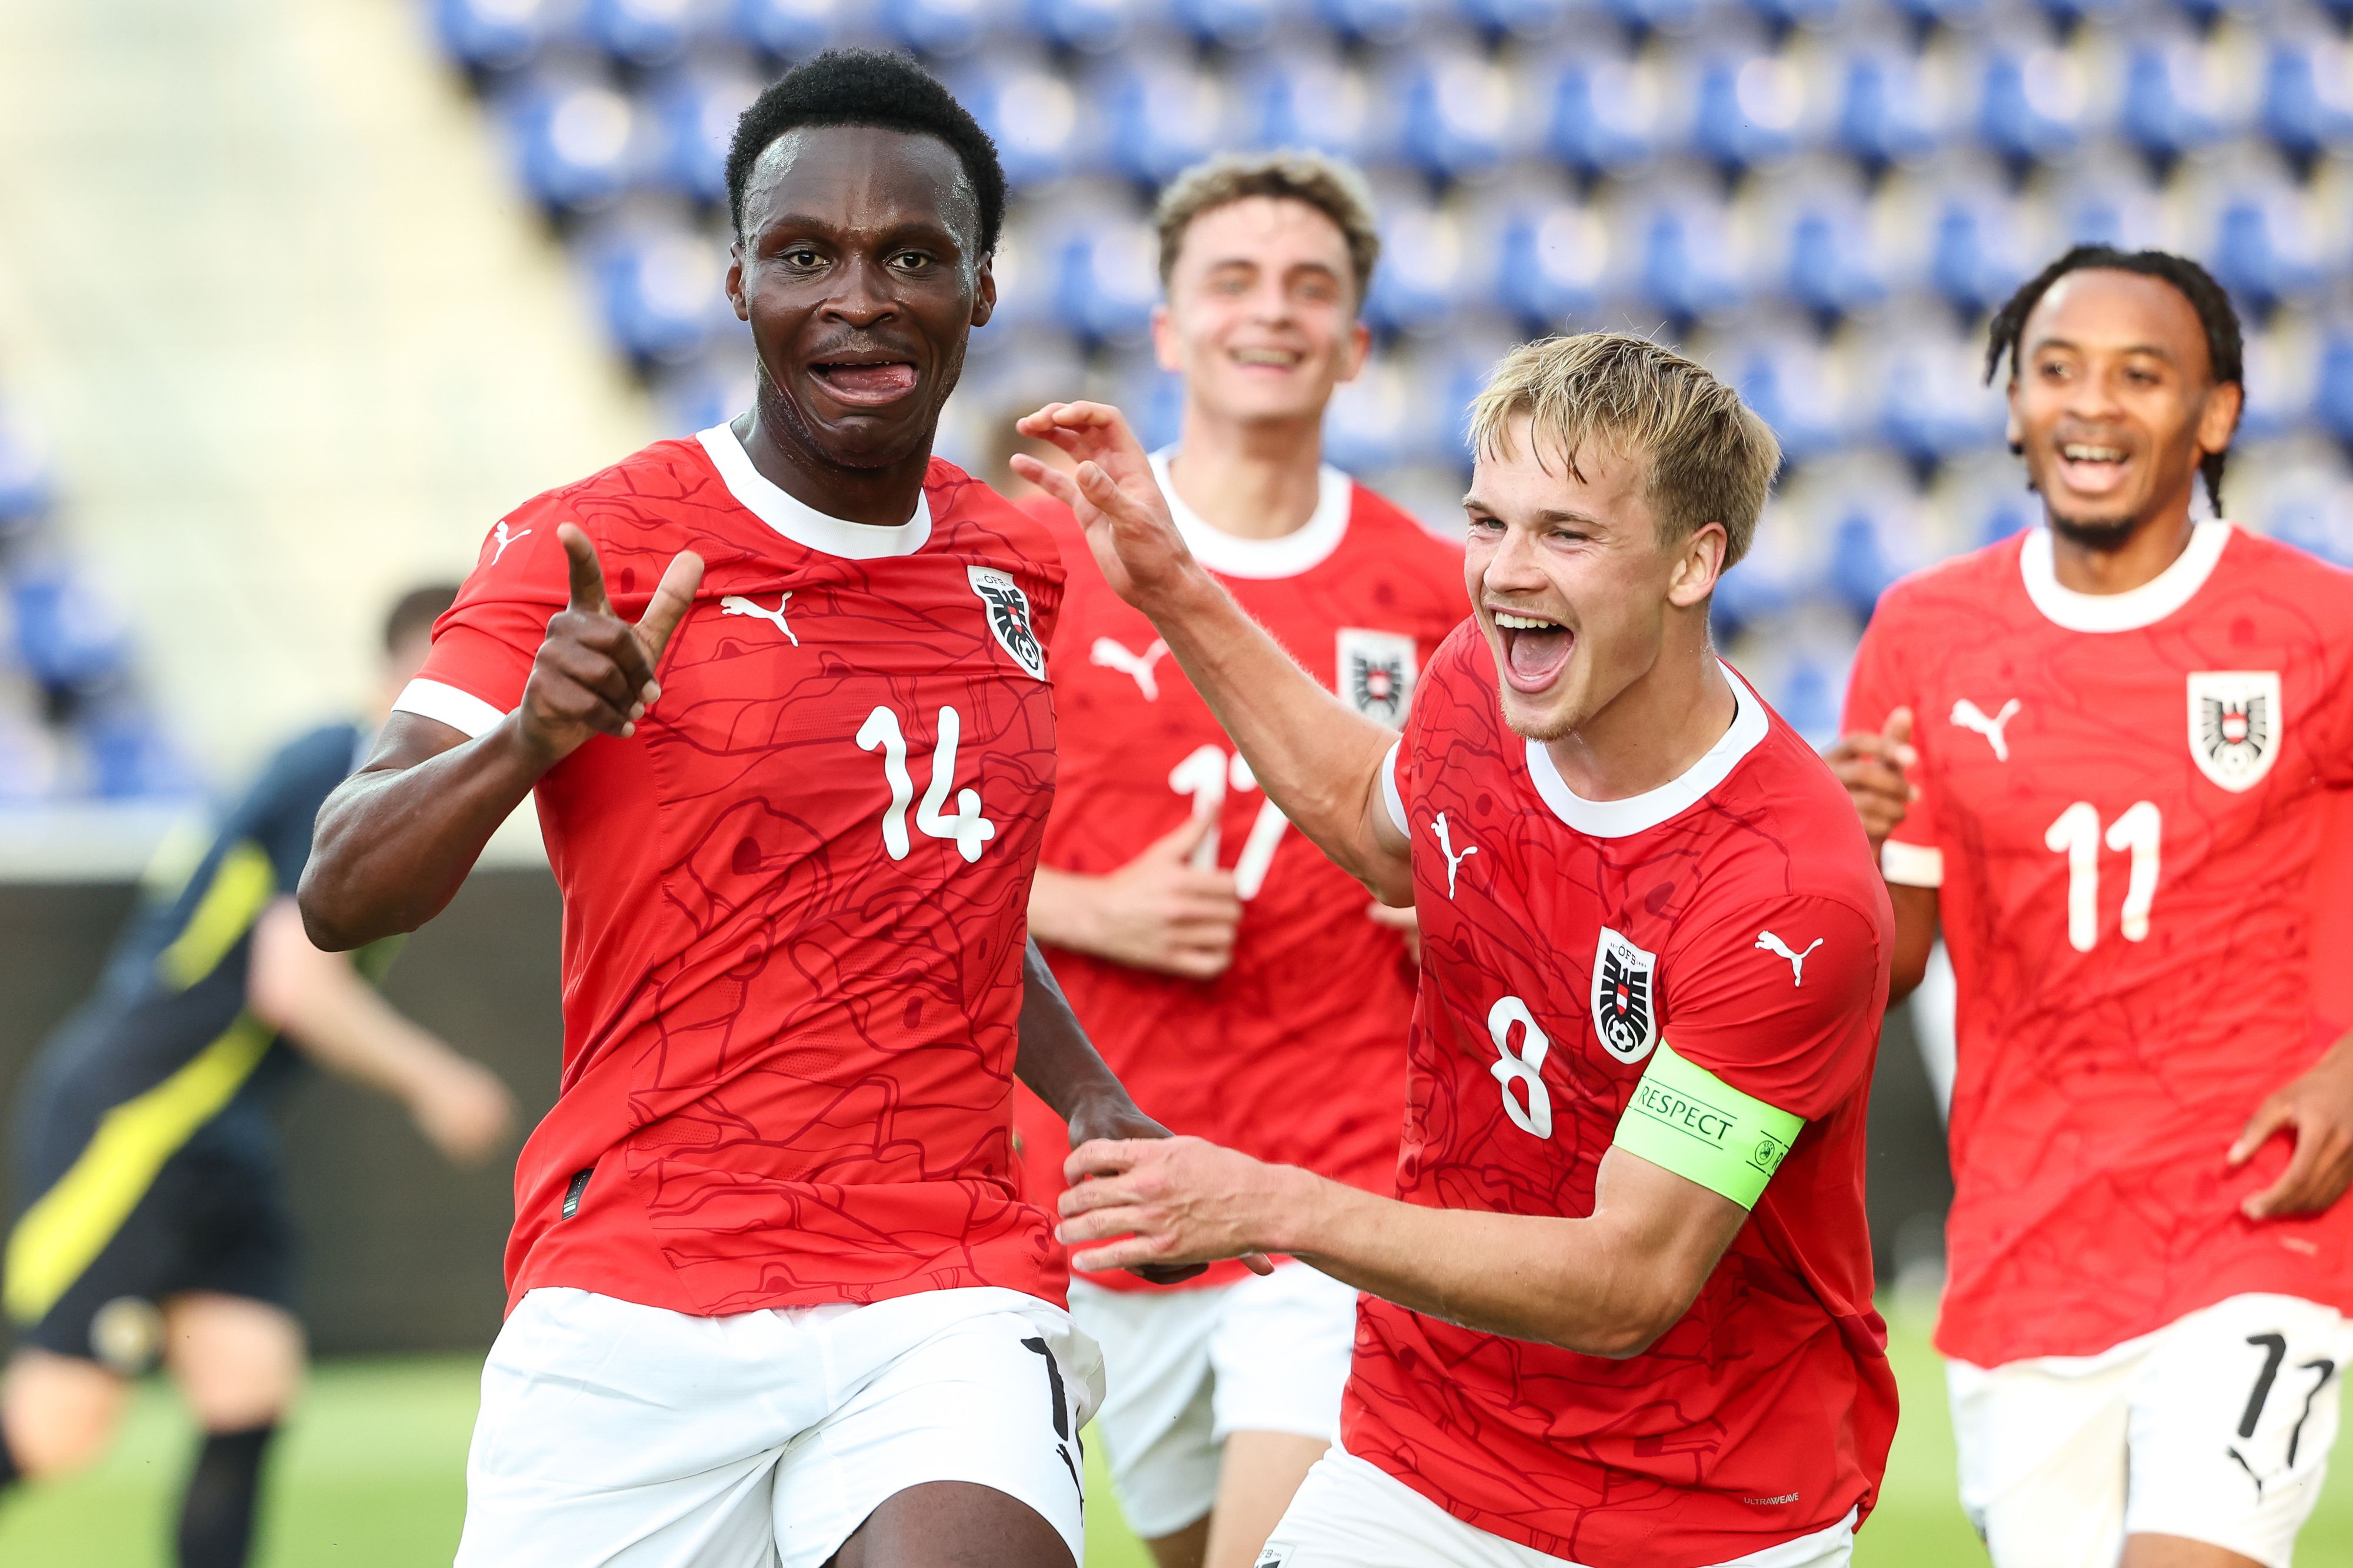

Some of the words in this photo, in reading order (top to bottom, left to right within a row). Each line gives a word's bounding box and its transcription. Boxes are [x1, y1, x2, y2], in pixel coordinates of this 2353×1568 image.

[855, 705, 996, 863] 14
[2044, 800, 2162, 953] 11
[1618, 943, 1636, 966] ÖFB
[1487, 995, 1552, 1140] 8
[1637, 1086, 1734, 1140] RESPECT
[1744, 1492, 1799, 1506] ULTRAWEAVE
